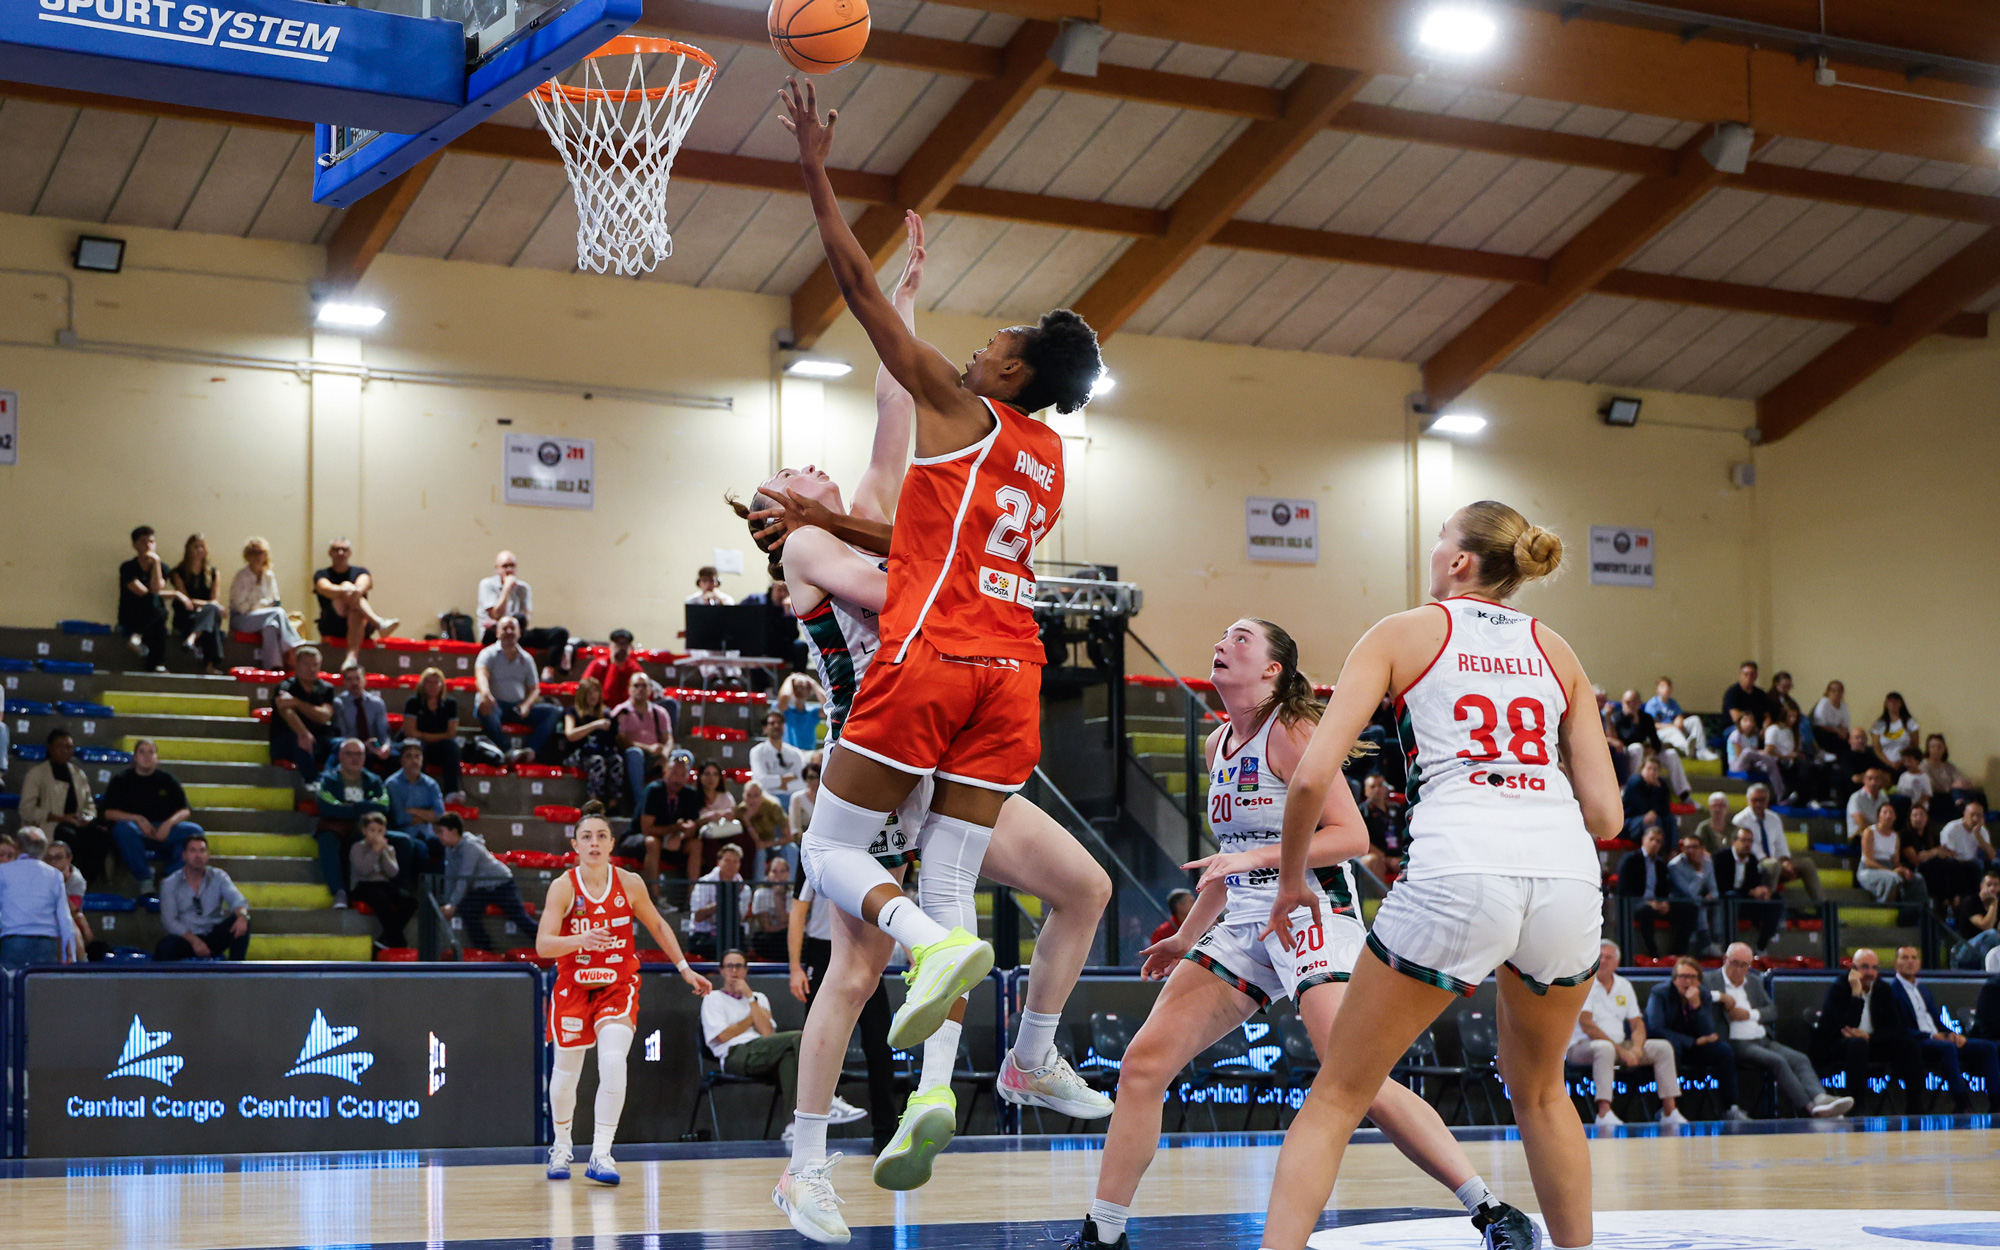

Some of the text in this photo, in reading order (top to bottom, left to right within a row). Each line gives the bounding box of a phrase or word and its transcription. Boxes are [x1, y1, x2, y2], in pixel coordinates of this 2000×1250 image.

[179, 5, 341, 52] SYSTEM
[984, 583, 1009, 597] VENOSTA
[1457, 653, 1543, 678] REDAELLI
[1453, 693, 1551, 766] 38
[1212, 793, 1232, 824] 20
[570, 917, 591, 935] 30
[1296, 924, 1324, 959] 20
[579, 970, 615, 981] Wüber
[66, 1095, 226, 1123] Central Cargo
[238, 1094, 421, 1124] Central Cargo
